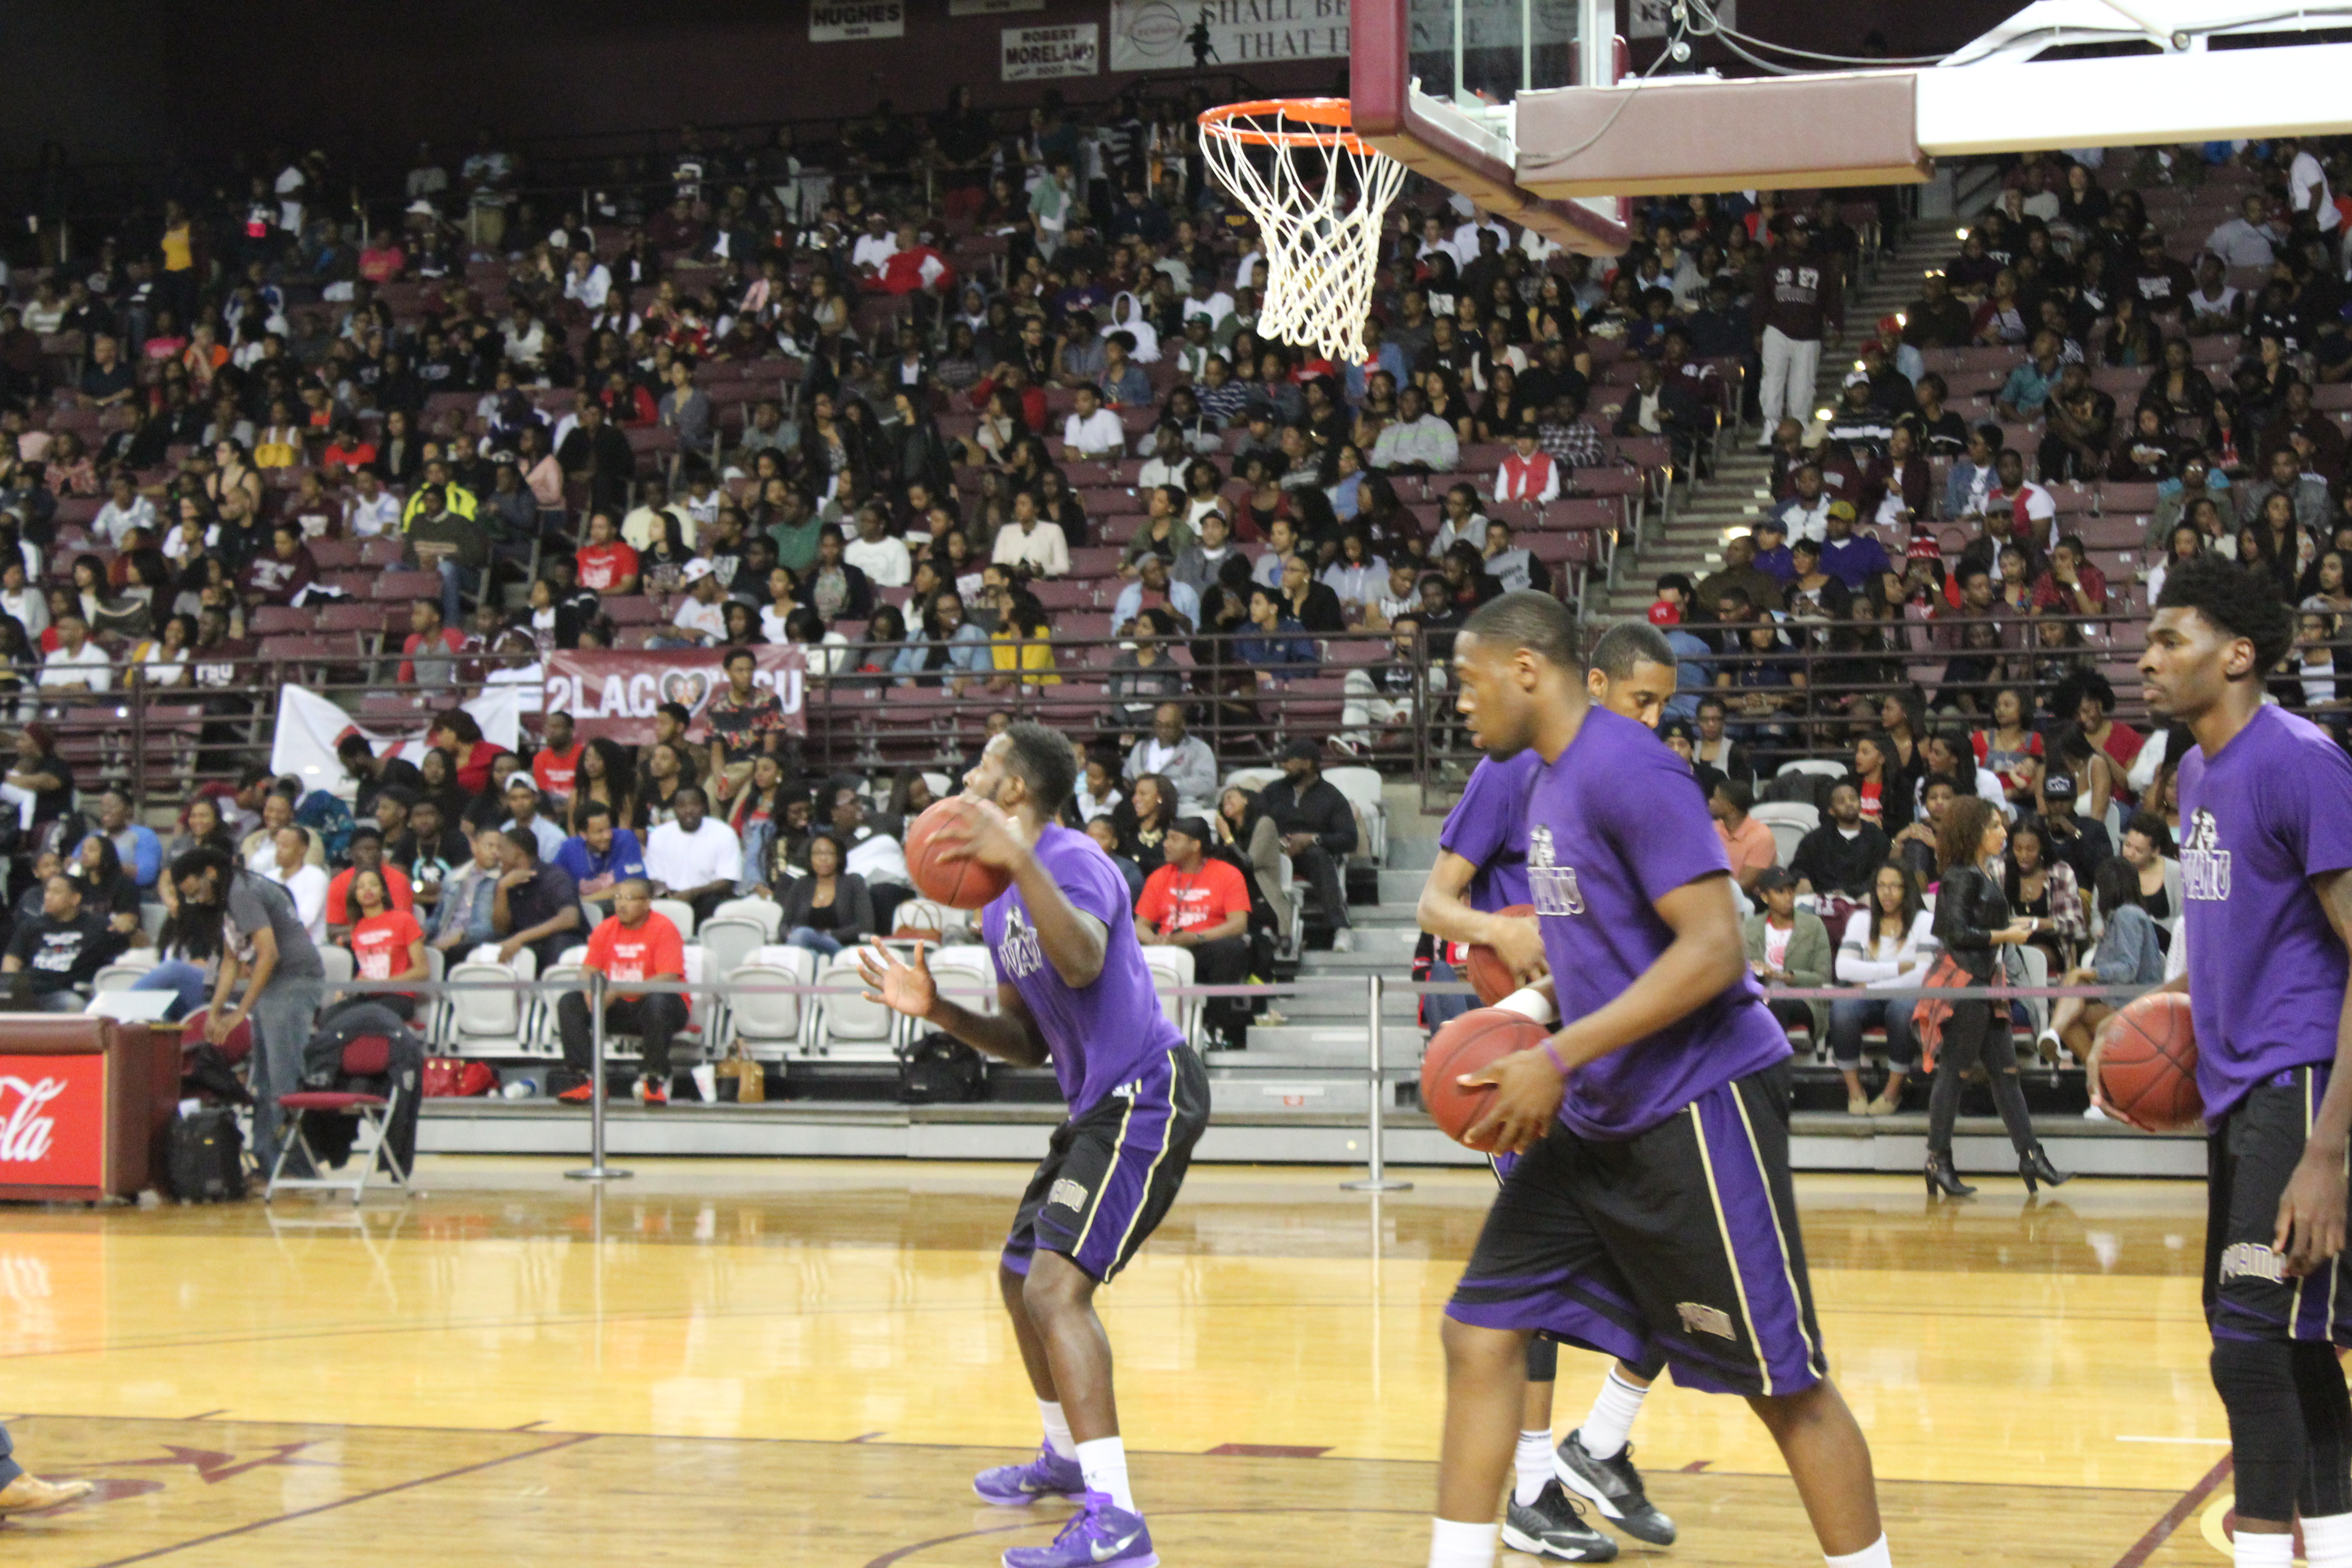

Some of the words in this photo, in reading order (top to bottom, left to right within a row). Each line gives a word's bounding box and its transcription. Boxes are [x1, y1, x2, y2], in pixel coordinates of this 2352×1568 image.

[1022, 28, 1077, 42] ROBERT
[1235, 28, 1317, 59] THAT
[546, 671, 657, 718] 2LAC
